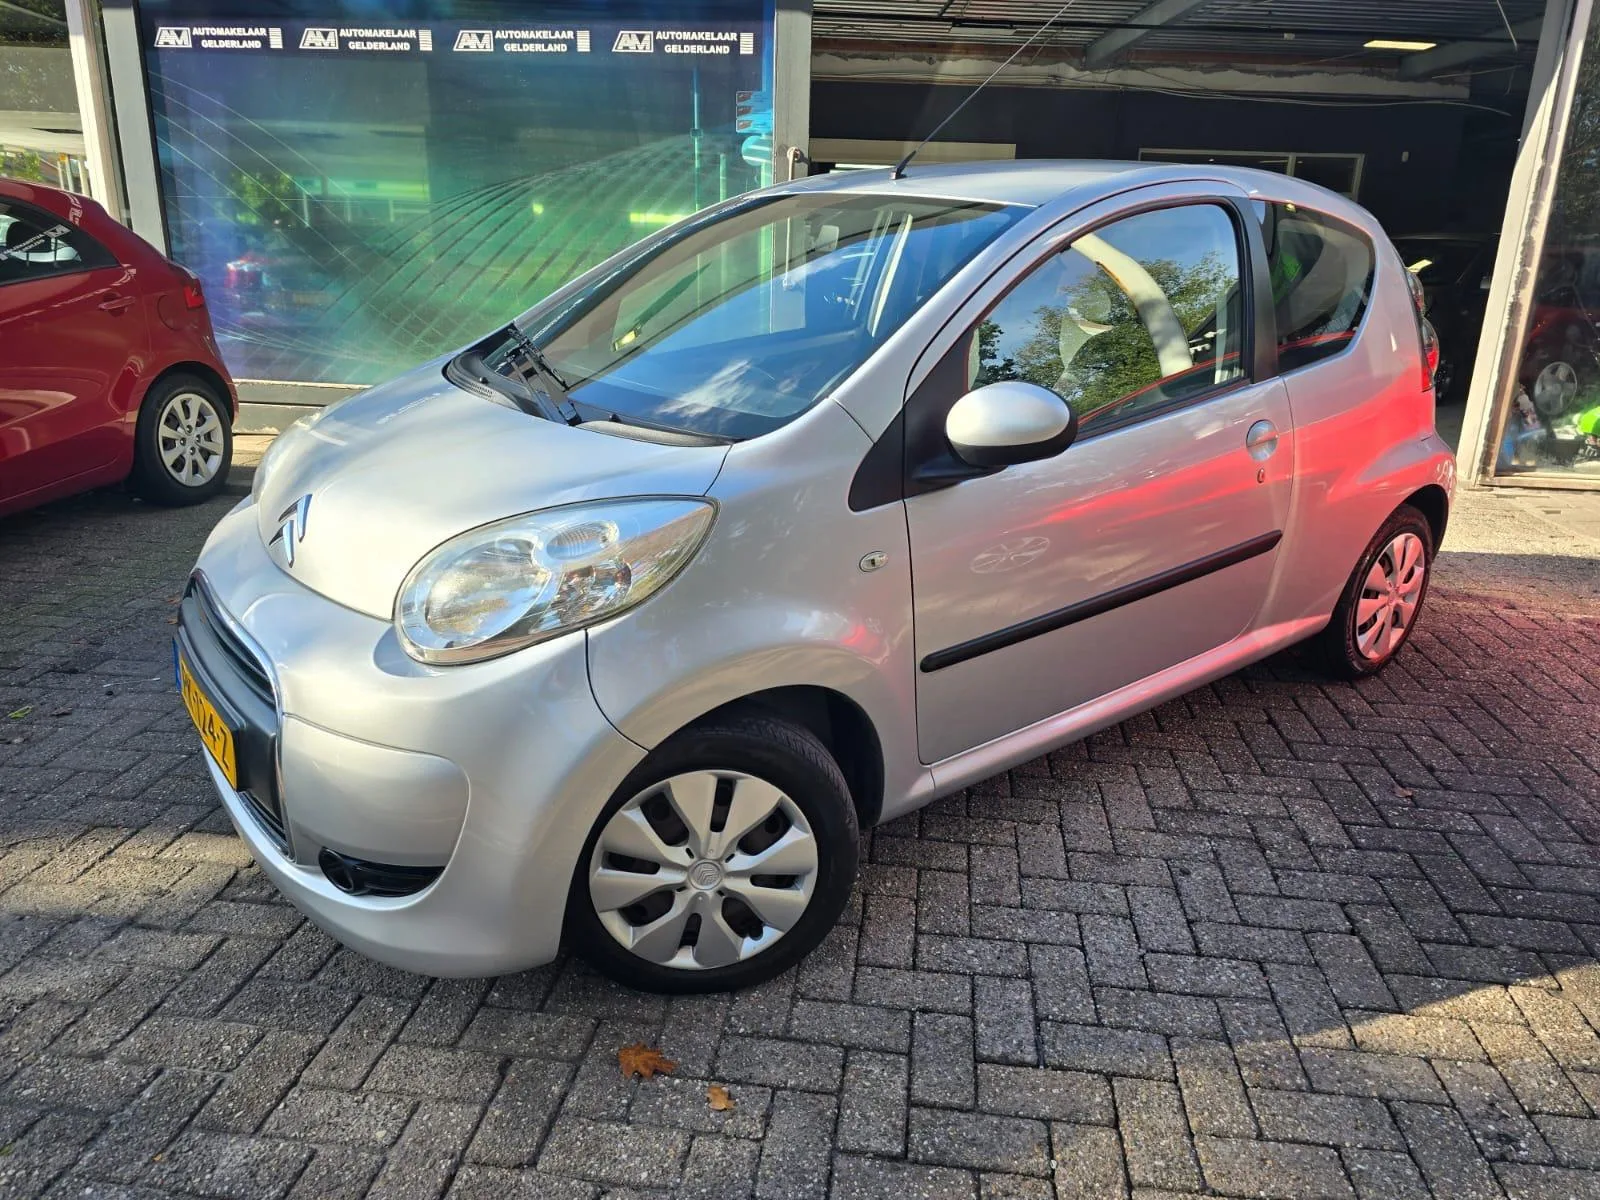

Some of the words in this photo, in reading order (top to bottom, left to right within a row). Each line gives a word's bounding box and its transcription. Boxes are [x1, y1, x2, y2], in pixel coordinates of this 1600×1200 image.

[192, 27, 267, 36] AUTOMAKELAAR
[339, 28, 416, 39] AUTOMAKELAAR
[495, 30, 574, 40] AUTOMAKELAAR
[656, 31, 737, 41] AUTOMAKELAAR
[157, 28, 191, 47] AM
[302, 29, 336, 48] AM
[457, 31, 491, 50] AM
[615, 32, 652, 51] AM
[201, 39, 262, 49] GELDERLAND
[348, 41, 411, 51] GELDERLAND
[504, 43, 567, 52] GELDERLAND
[664, 44, 730, 54] GELDERLAND
